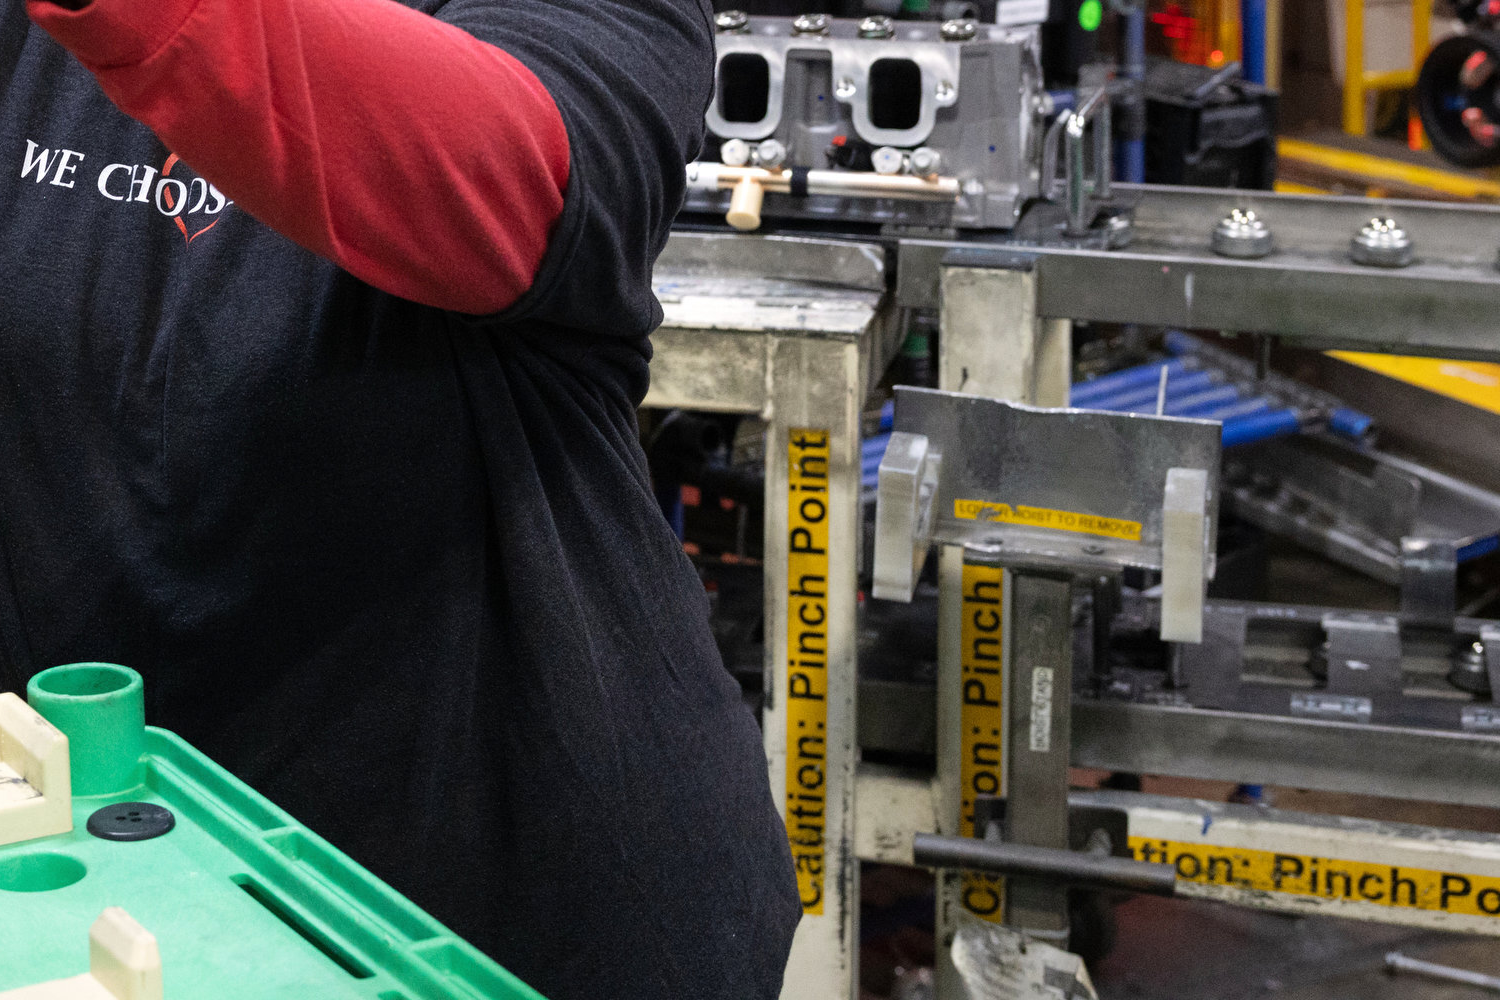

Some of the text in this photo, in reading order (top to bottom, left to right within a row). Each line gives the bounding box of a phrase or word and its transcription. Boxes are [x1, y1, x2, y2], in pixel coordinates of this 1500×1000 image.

[20, 138, 235, 217] WE CHOOS
[788, 435, 827, 909] Caution: Pinch Point
[963, 580, 1001, 708] Pinch
[1271, 853, 1418, 906] Pinch
[1439, 872, 1500, 916] Po
